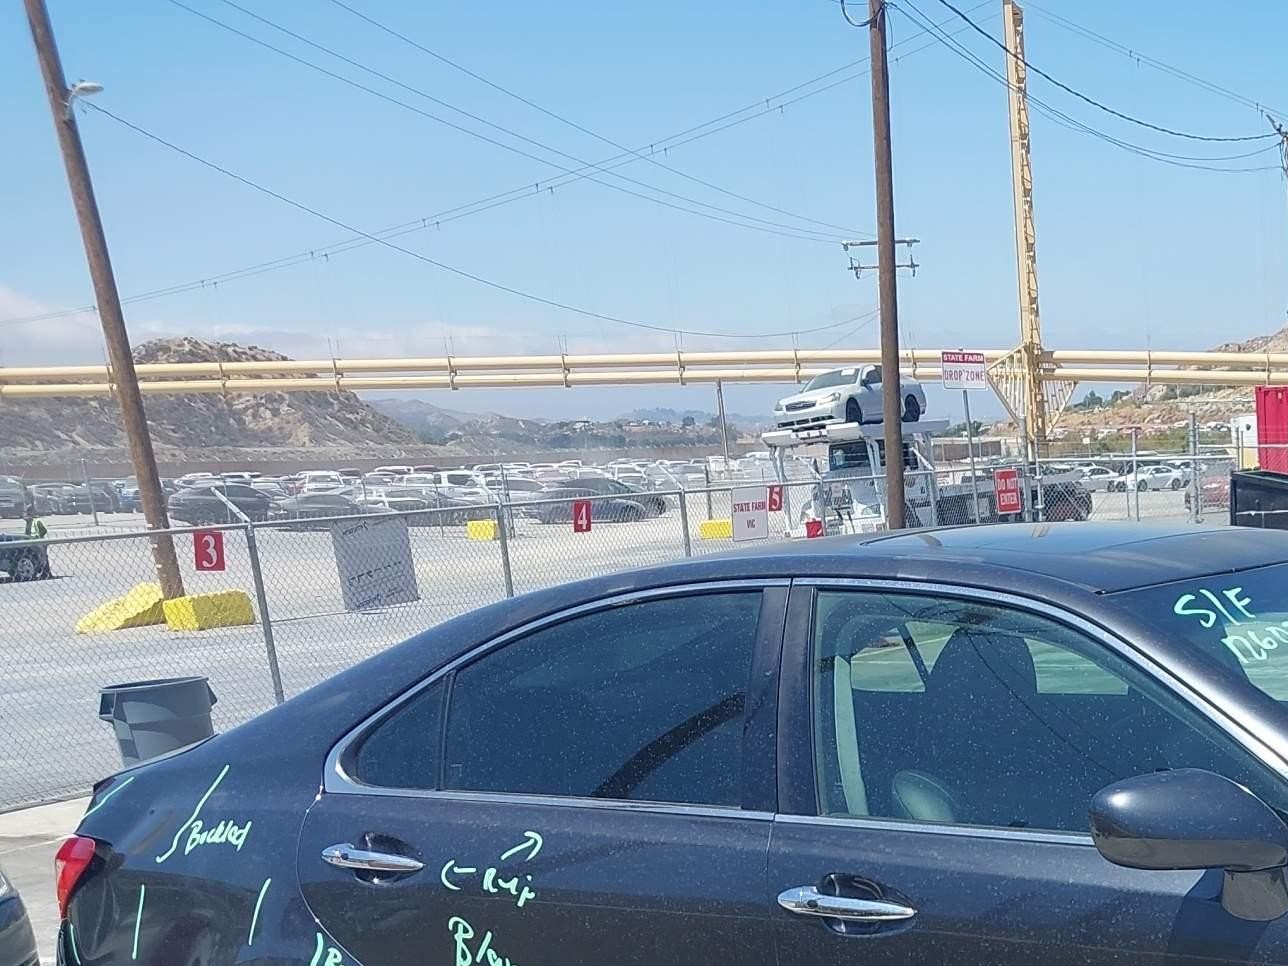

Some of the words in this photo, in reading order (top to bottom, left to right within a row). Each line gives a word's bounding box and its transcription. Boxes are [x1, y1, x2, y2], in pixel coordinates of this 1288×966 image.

[943, 353, 963, 362] STATE
[964, 354, 984, 363] FARM
[944, 370, 963, 381] DROP
[965, 370, 985, 382] ZONE
[997, 478, 1006, 490] DO
[1007, 477, 1017, 490] NOT
[772, 485, 780, 509] 5
[1000, 492, 1018, 506] ENTER
[733, 502, 750, 513] STATE
[751, 500, 766, 512] FARM
[577, 503, 588, 530] 4
[201, 535, 218, 568] 3
